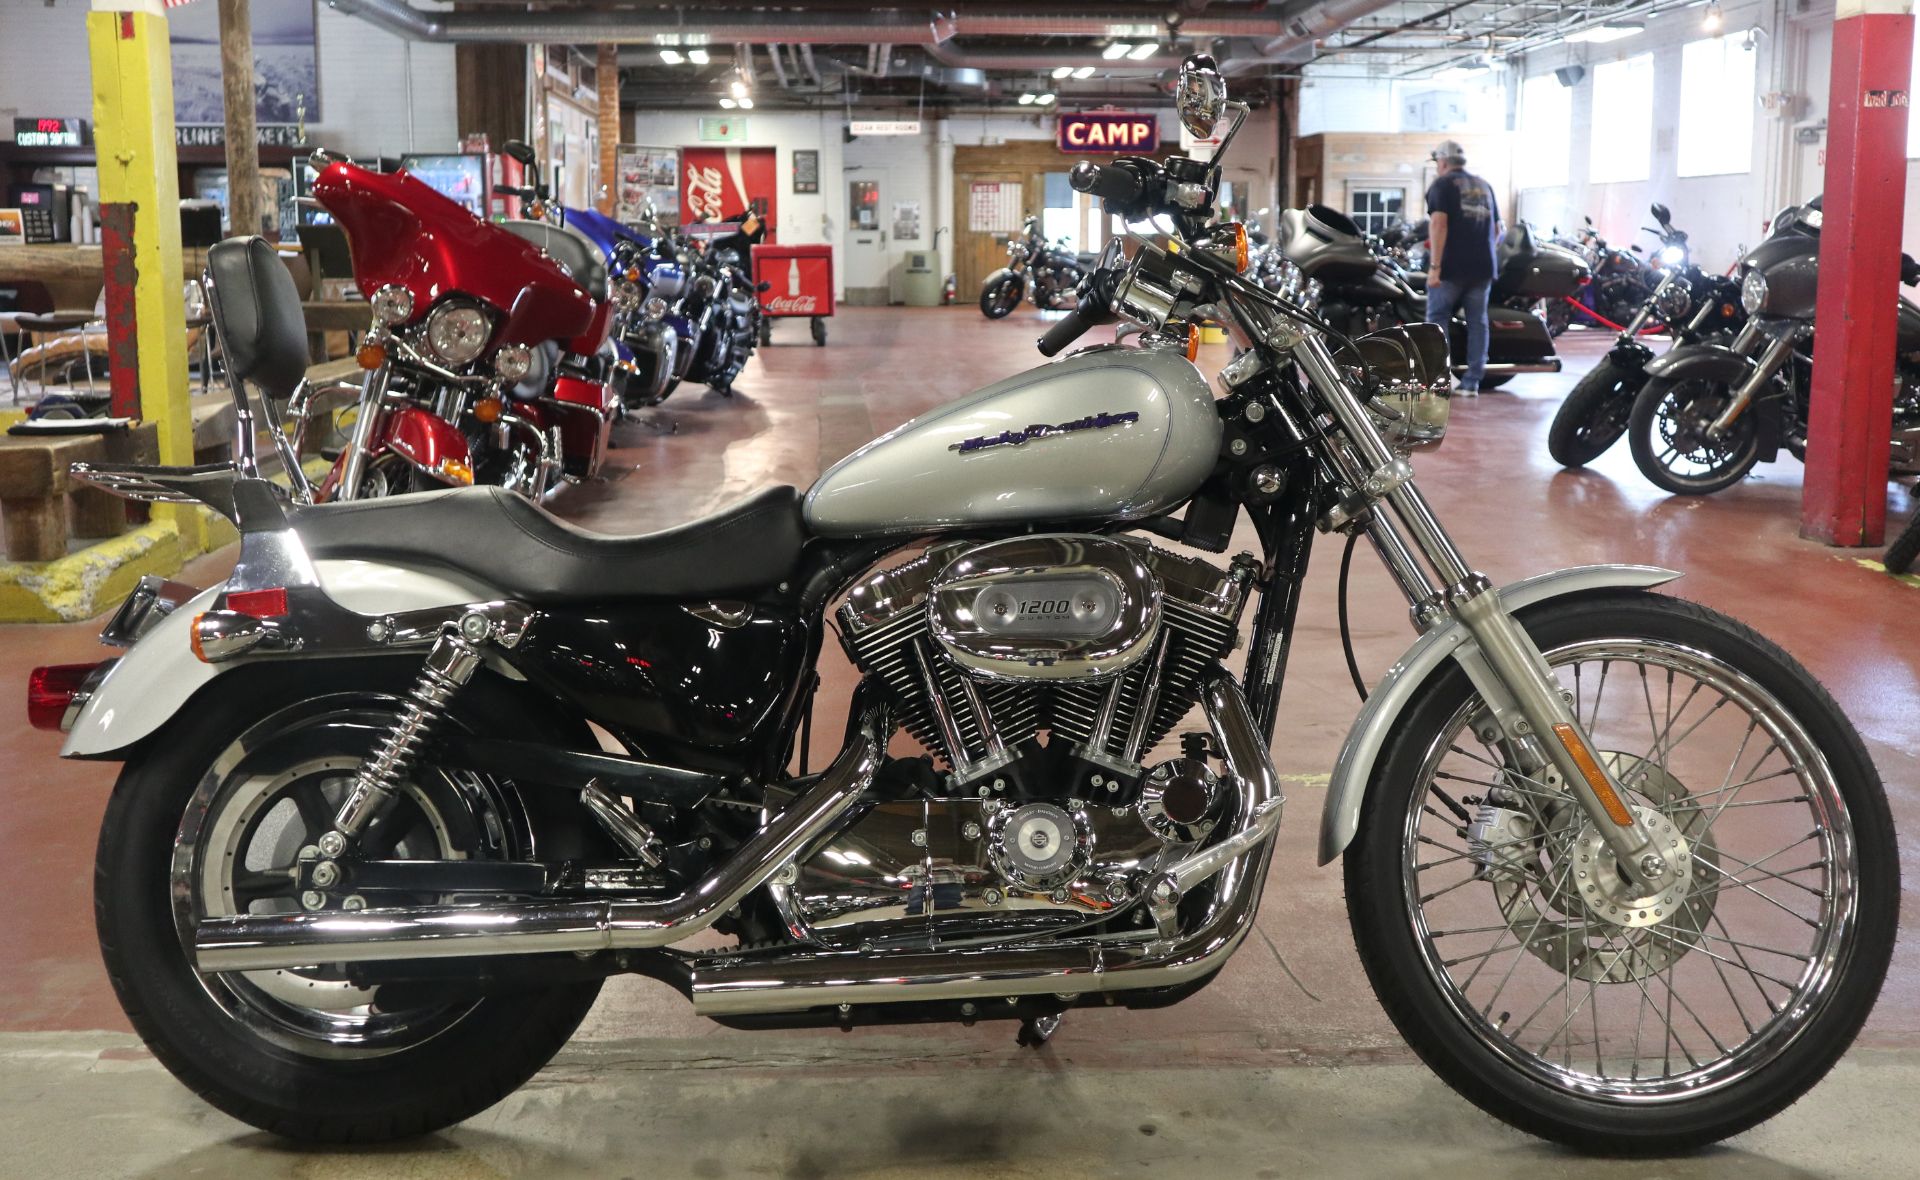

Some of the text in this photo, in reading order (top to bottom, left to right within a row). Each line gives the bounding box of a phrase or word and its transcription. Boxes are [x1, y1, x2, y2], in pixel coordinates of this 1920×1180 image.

[38, 119, 60, 132] 1992
[18, 132, 48, 146] CUSTOM
[1067, 122, 1149, 145] CAMP
[1020, 600, 1069, 614] 1200
